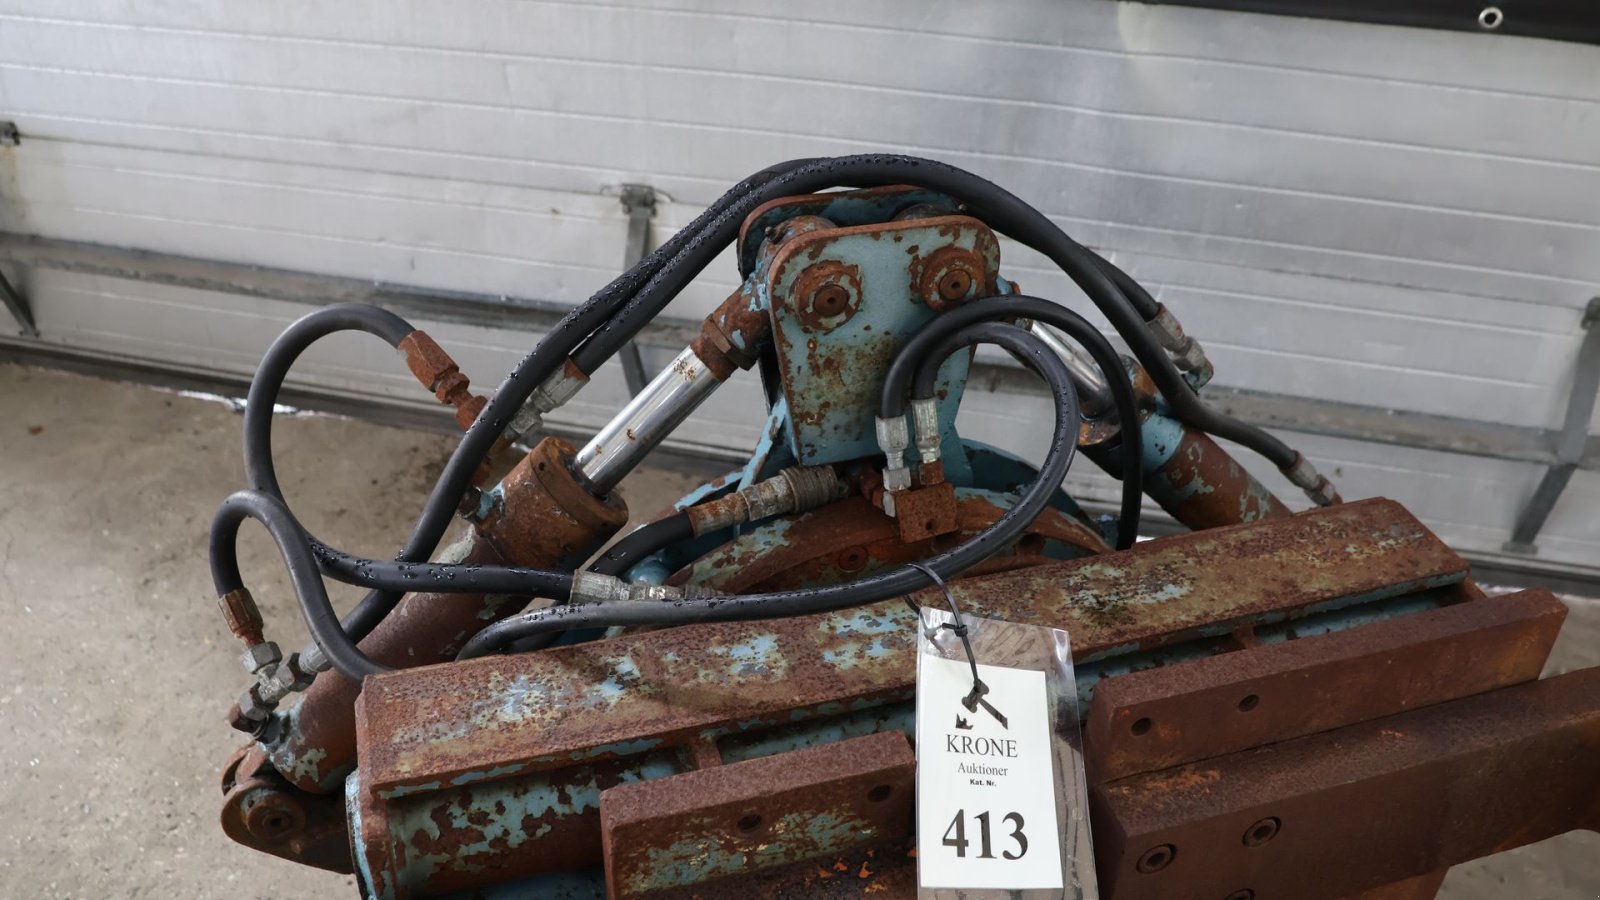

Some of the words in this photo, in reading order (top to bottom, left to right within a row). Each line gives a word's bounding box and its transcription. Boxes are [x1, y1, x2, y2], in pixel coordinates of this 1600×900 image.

[946, 734, 1018, 758] KRONE
[957, 762, 1008, 776] Auktioner
[969, 778, 984, 786] Kat.
[986, 779, 997, 787] Nr.
[942, 808, 1029, 861] 413
